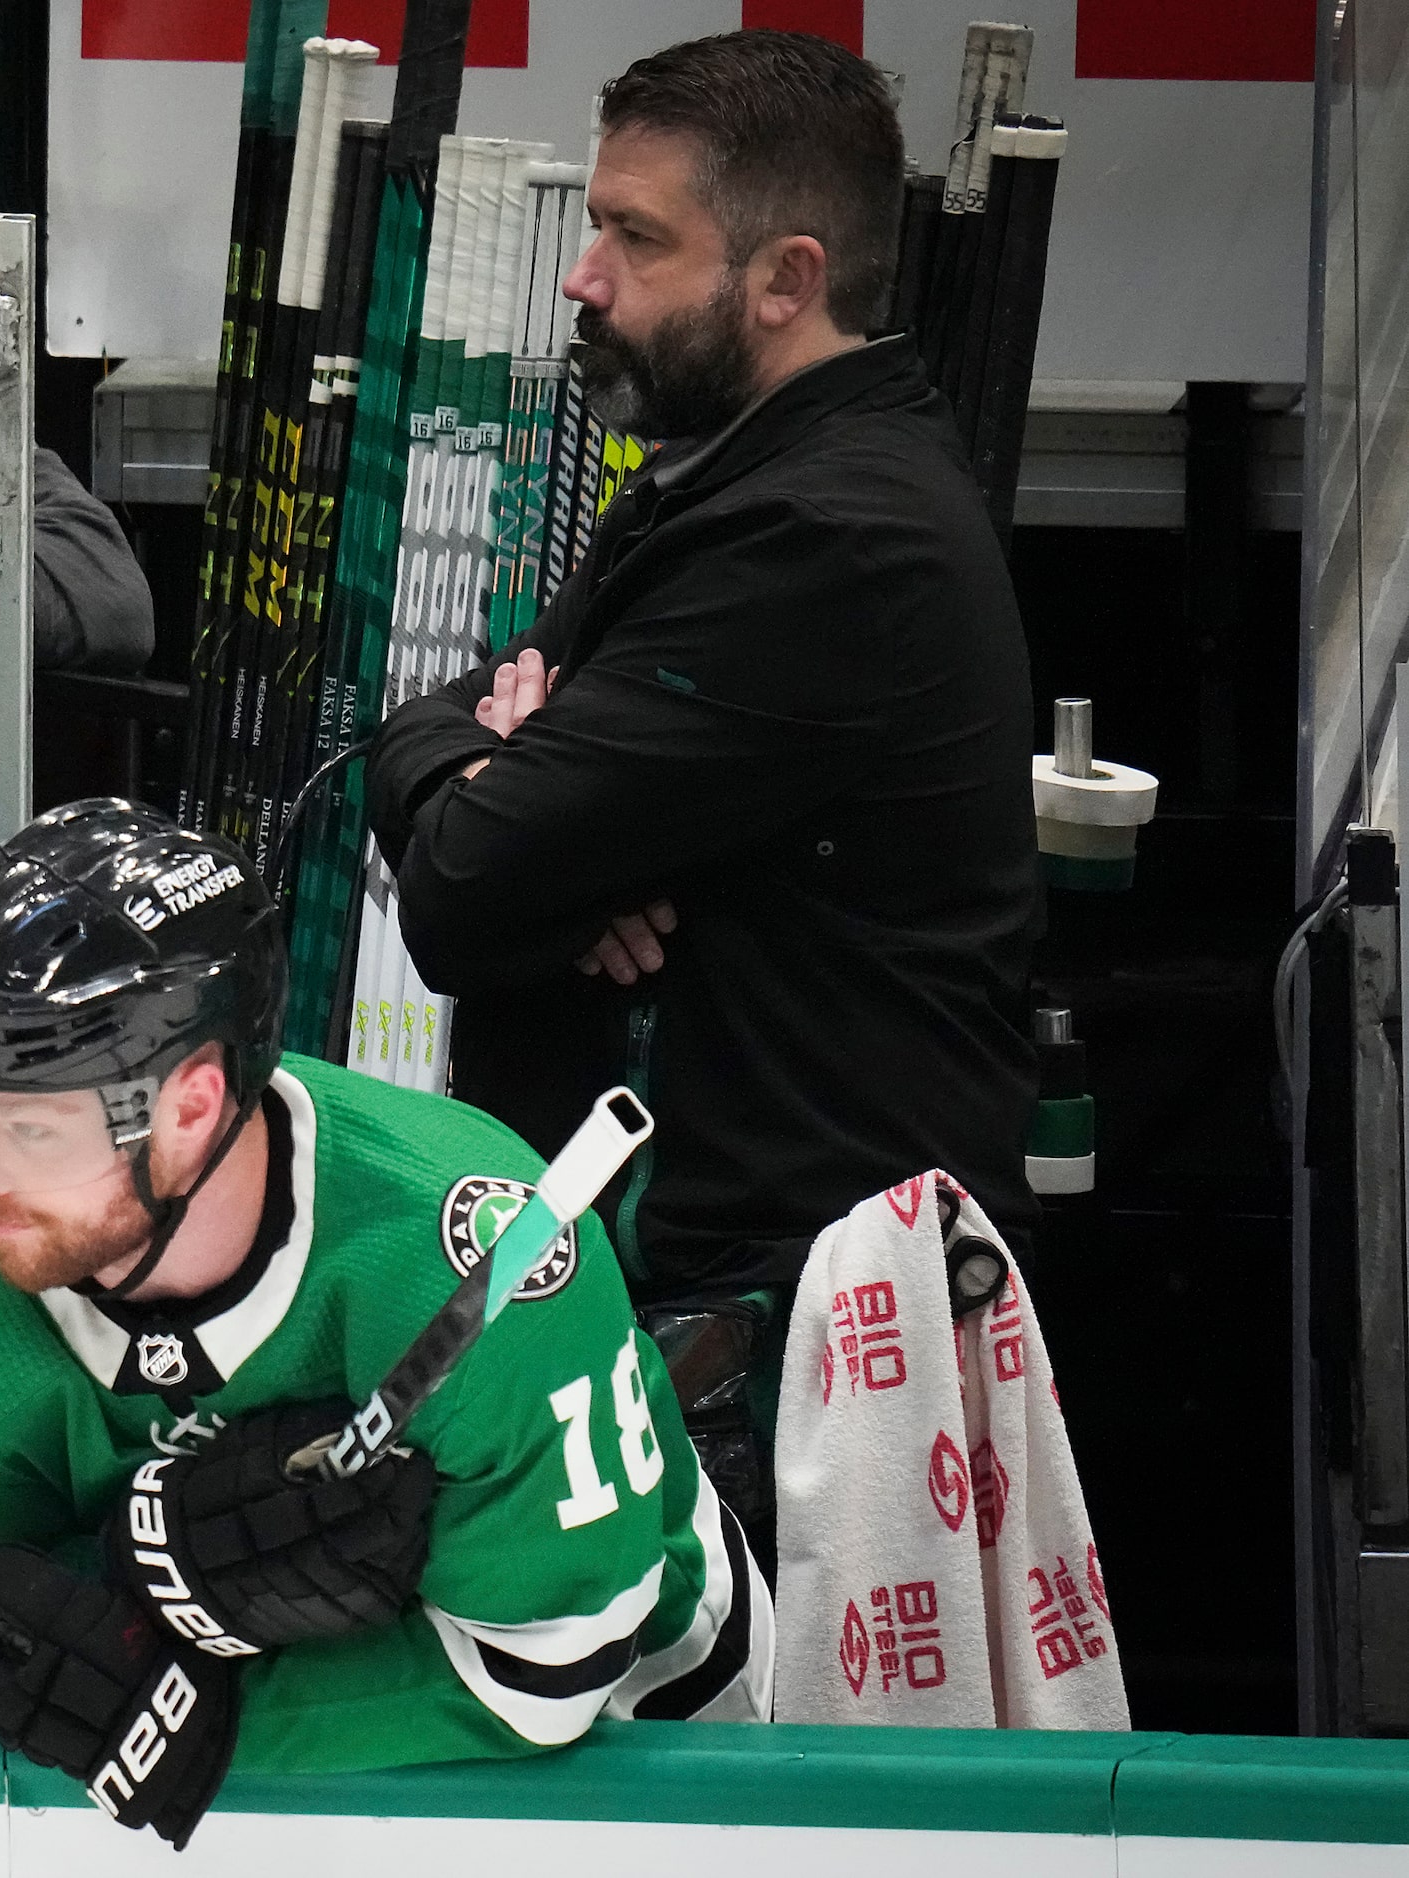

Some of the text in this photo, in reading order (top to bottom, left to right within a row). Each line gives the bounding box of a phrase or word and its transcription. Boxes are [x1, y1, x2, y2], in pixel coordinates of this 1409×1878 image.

[943, 190, 965, 211] 55
[966, 188, 987, 210] 55
[414, 422, 428, 437] 16
[439, 414, 454, 429] 16
[458, 435, 471, 449] 16
[480, 430, 493, 445] 16
[243, 406, 283, 620] CCM
[265, 416, 304, 628] CCM
[572, 408, 603, 576] ARRI
[231, 667, 246, 739] HEISKANEN
[252, 675, 267, 747] HEISKANEN
[318, 676, 338, 749] FAKSA 12
[340, 683, 357, 735] FAKSA
[177, 789, 188, 826] HAK
[194, 799, 205, 831] HAK
[256, 797, 273, 878] DELLAND
[152, 852, 218, 899] ENERGY
[163, 864, 245, 916] TRANSFER
[853, 1281, 907, 1391] BIO
[548, 1327, 665, 1531] 18
[870, 1586, 900, 1694] STEEL
[894, 1580, 946, 1690] BIO
[1027, 1567, 1084, 1680] BIO
[1053, 1555, 1108, 1659] STEEL
[87, 1661, 198, 1819] BAU
